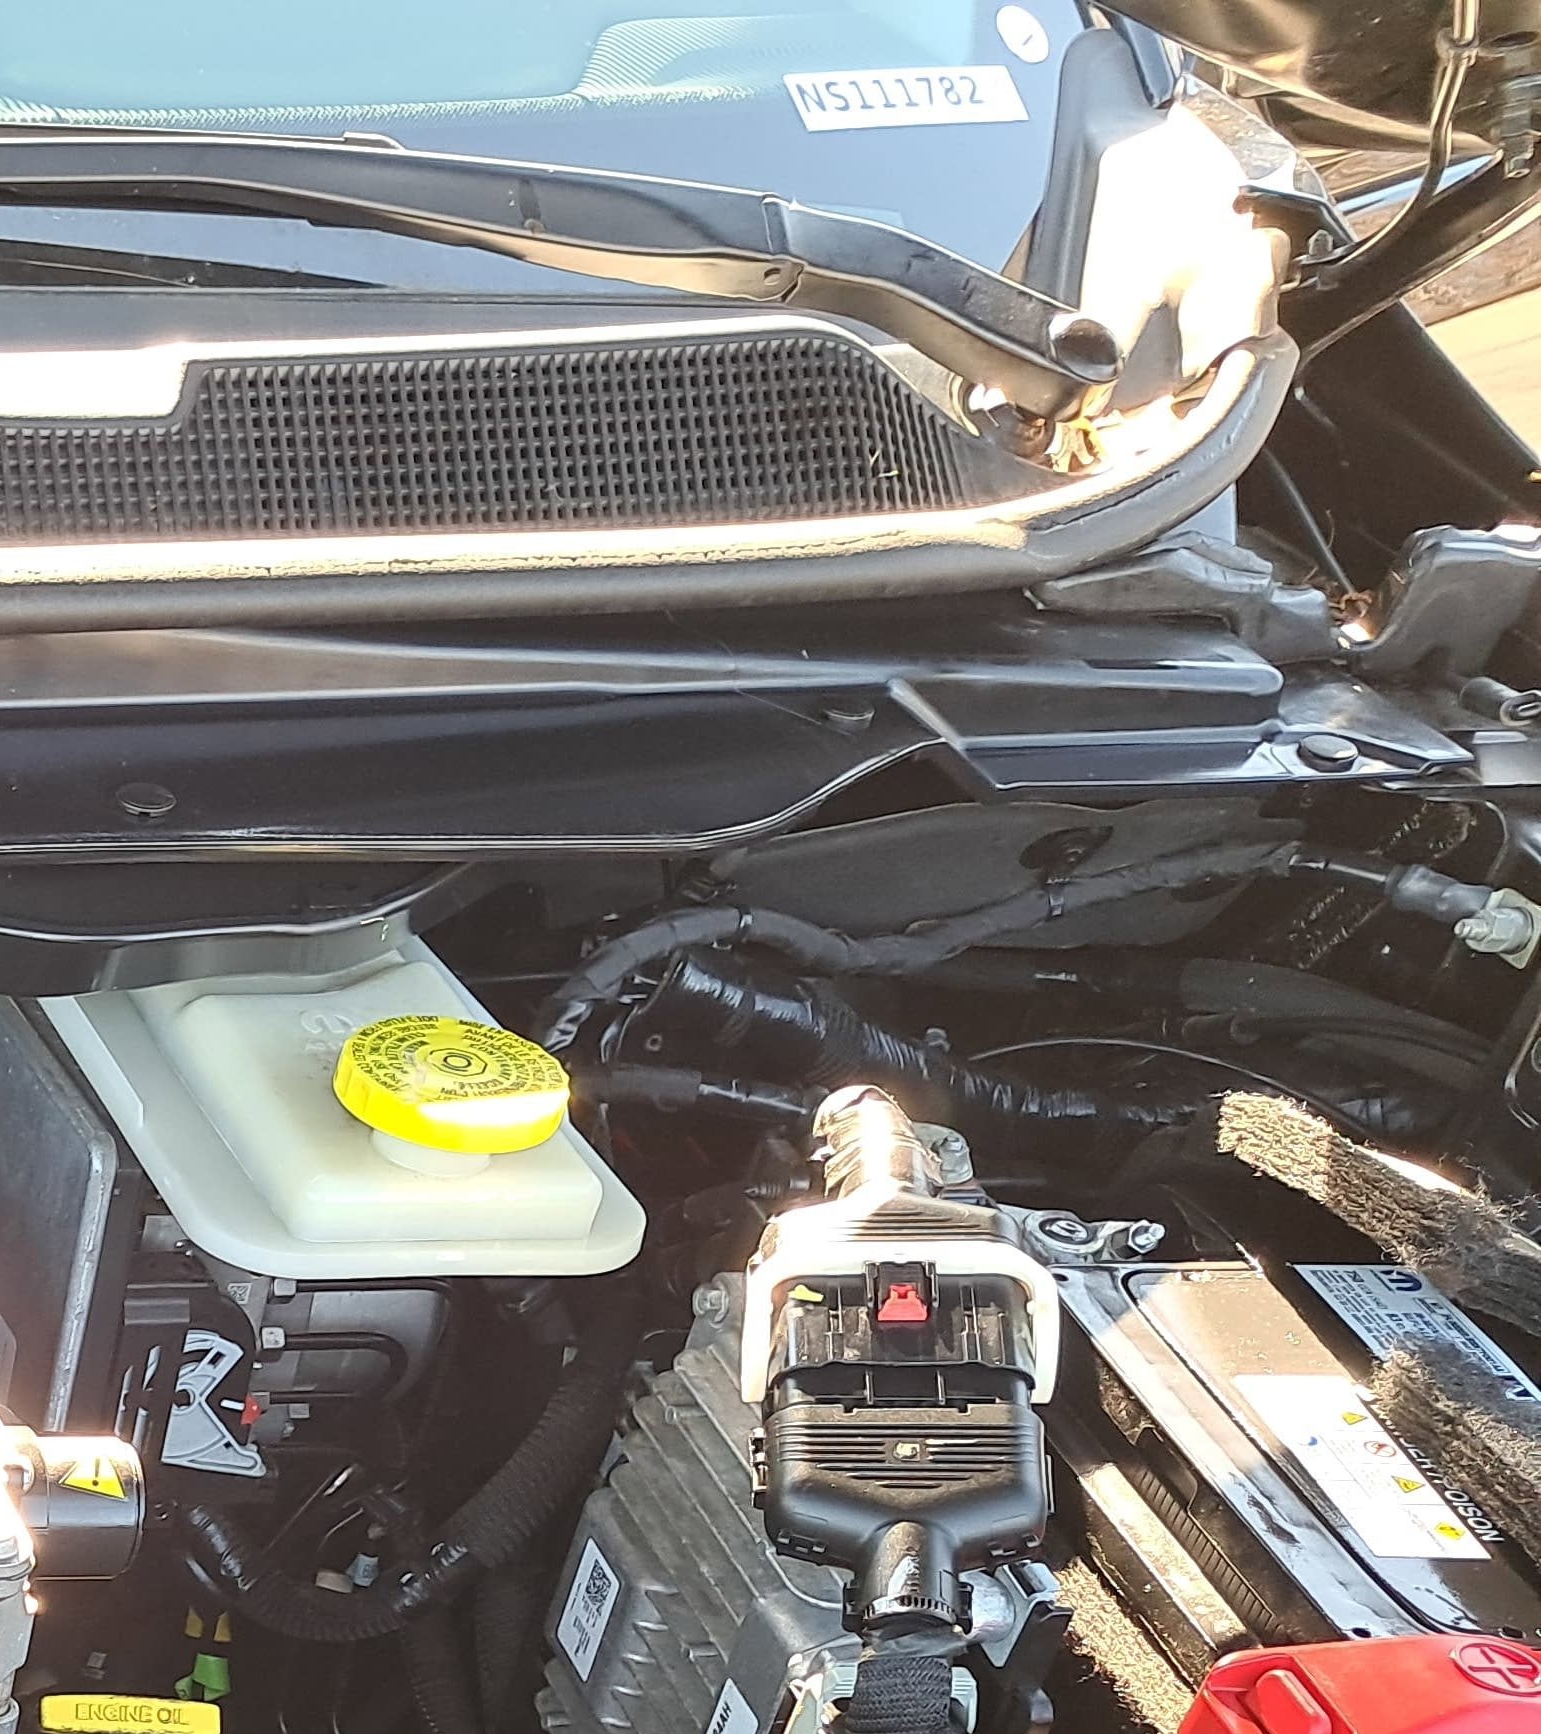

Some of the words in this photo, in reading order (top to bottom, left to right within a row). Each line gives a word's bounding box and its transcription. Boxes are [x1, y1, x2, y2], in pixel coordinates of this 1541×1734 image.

[795, 76, 984, 113] NS111782
[74, 1703, 153, 1723] ENGINE
[156, 1706, 190, 1726] OIL
